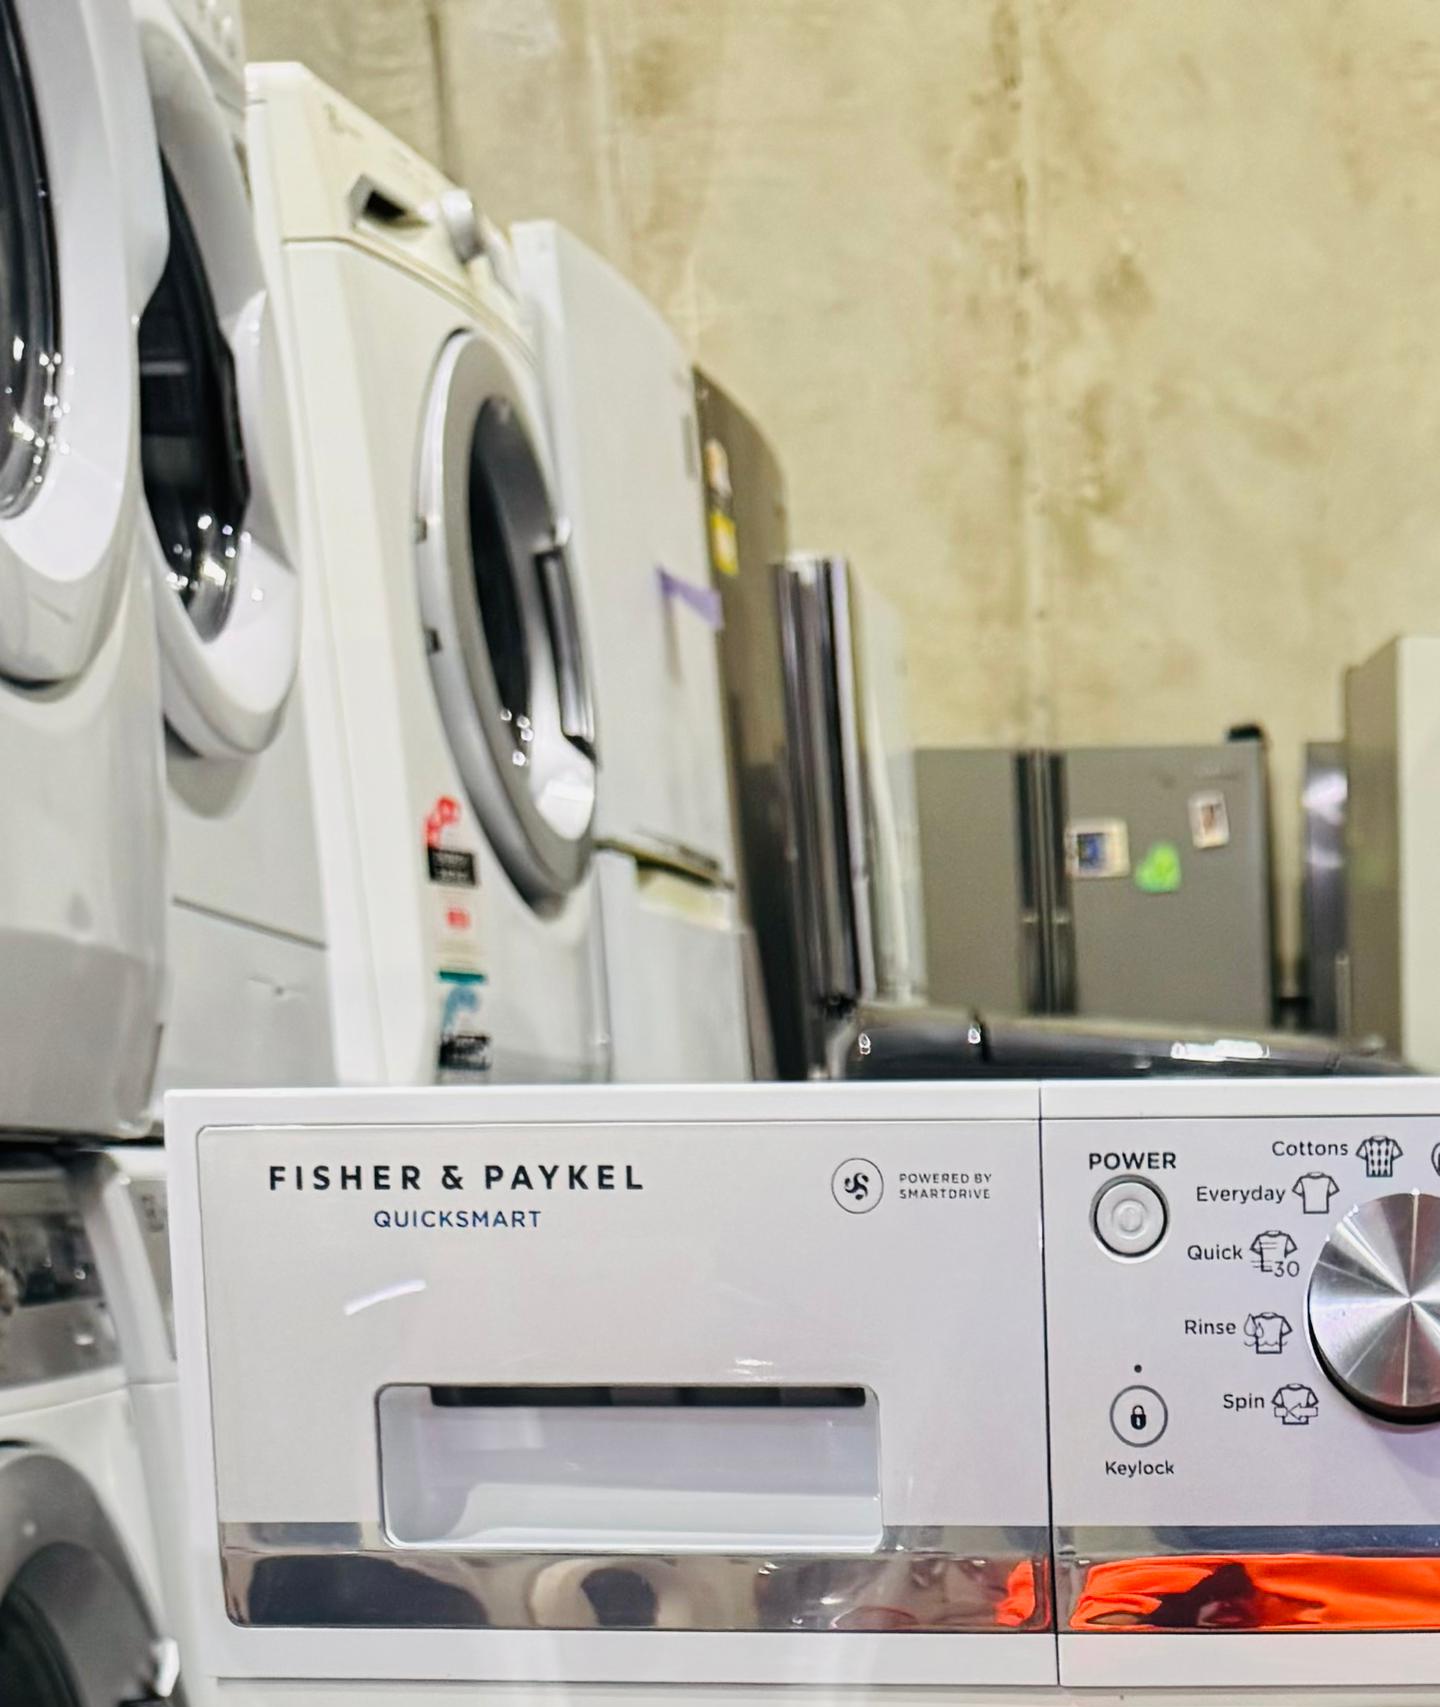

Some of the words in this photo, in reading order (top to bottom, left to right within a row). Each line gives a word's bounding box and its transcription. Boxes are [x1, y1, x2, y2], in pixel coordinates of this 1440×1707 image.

[1272, 1141, 1348, 1156] Cottons
[1089, 1152, 1176, 1170] POWER
[270, 1166, 420, 1190] FISHER
[442, 1165, 463, 1190] &
[485, 1165, 643, 1189] PAYKEL
[900, 1173, 969, 1183] POWERED
[974, 1173, 991, 1183] BY
[900, 1189, 989, 1199] SMARTDRIVE
[1197, 1185, 1285, 1204] Everyday
[374, 1211, 541, 1227] QUICKSMART
[1188, 1244, 1242, 1260] Quick
[1274, 1261, 1300, 1277] 30
[1185, 1319, 1236, 1334] Rinse
[1224, 1393, 1264, 1411] Spin
[1106, 1460, 1174, 1478] Keylock
